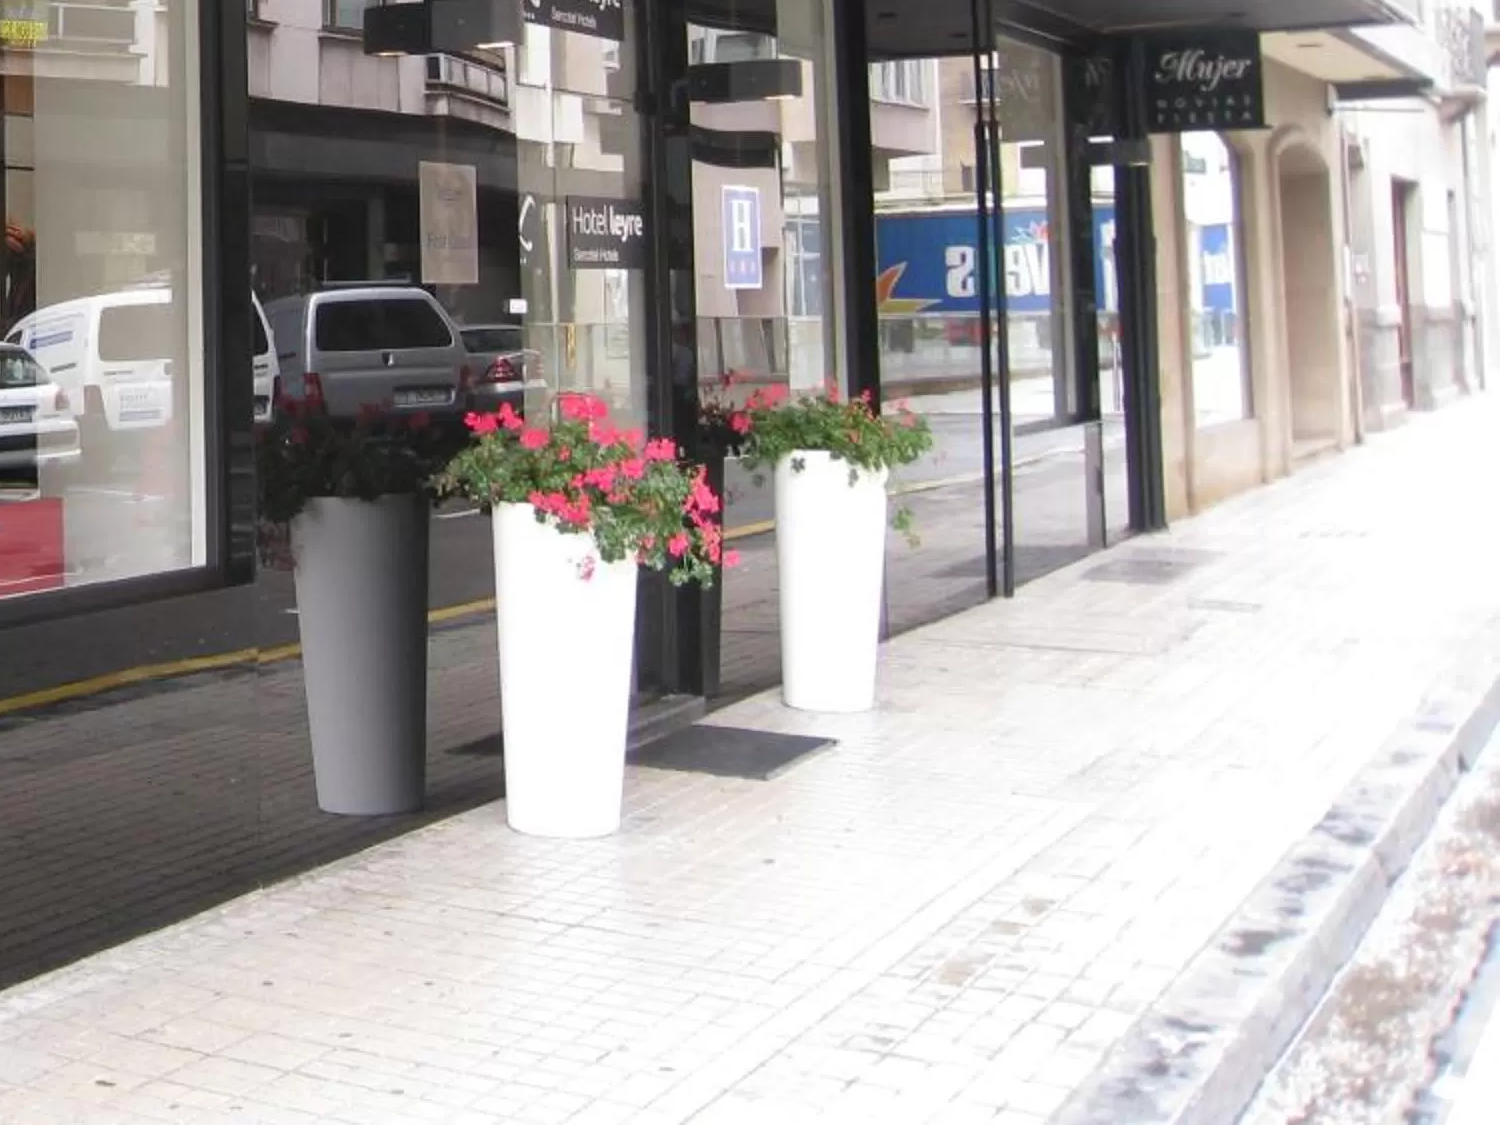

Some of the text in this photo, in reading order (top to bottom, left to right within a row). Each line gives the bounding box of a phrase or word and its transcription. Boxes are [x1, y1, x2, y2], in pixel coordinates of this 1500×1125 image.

[1154, 49, 1253, 92] Mujer
[572, 204, 644, 243] Hotel leyre
